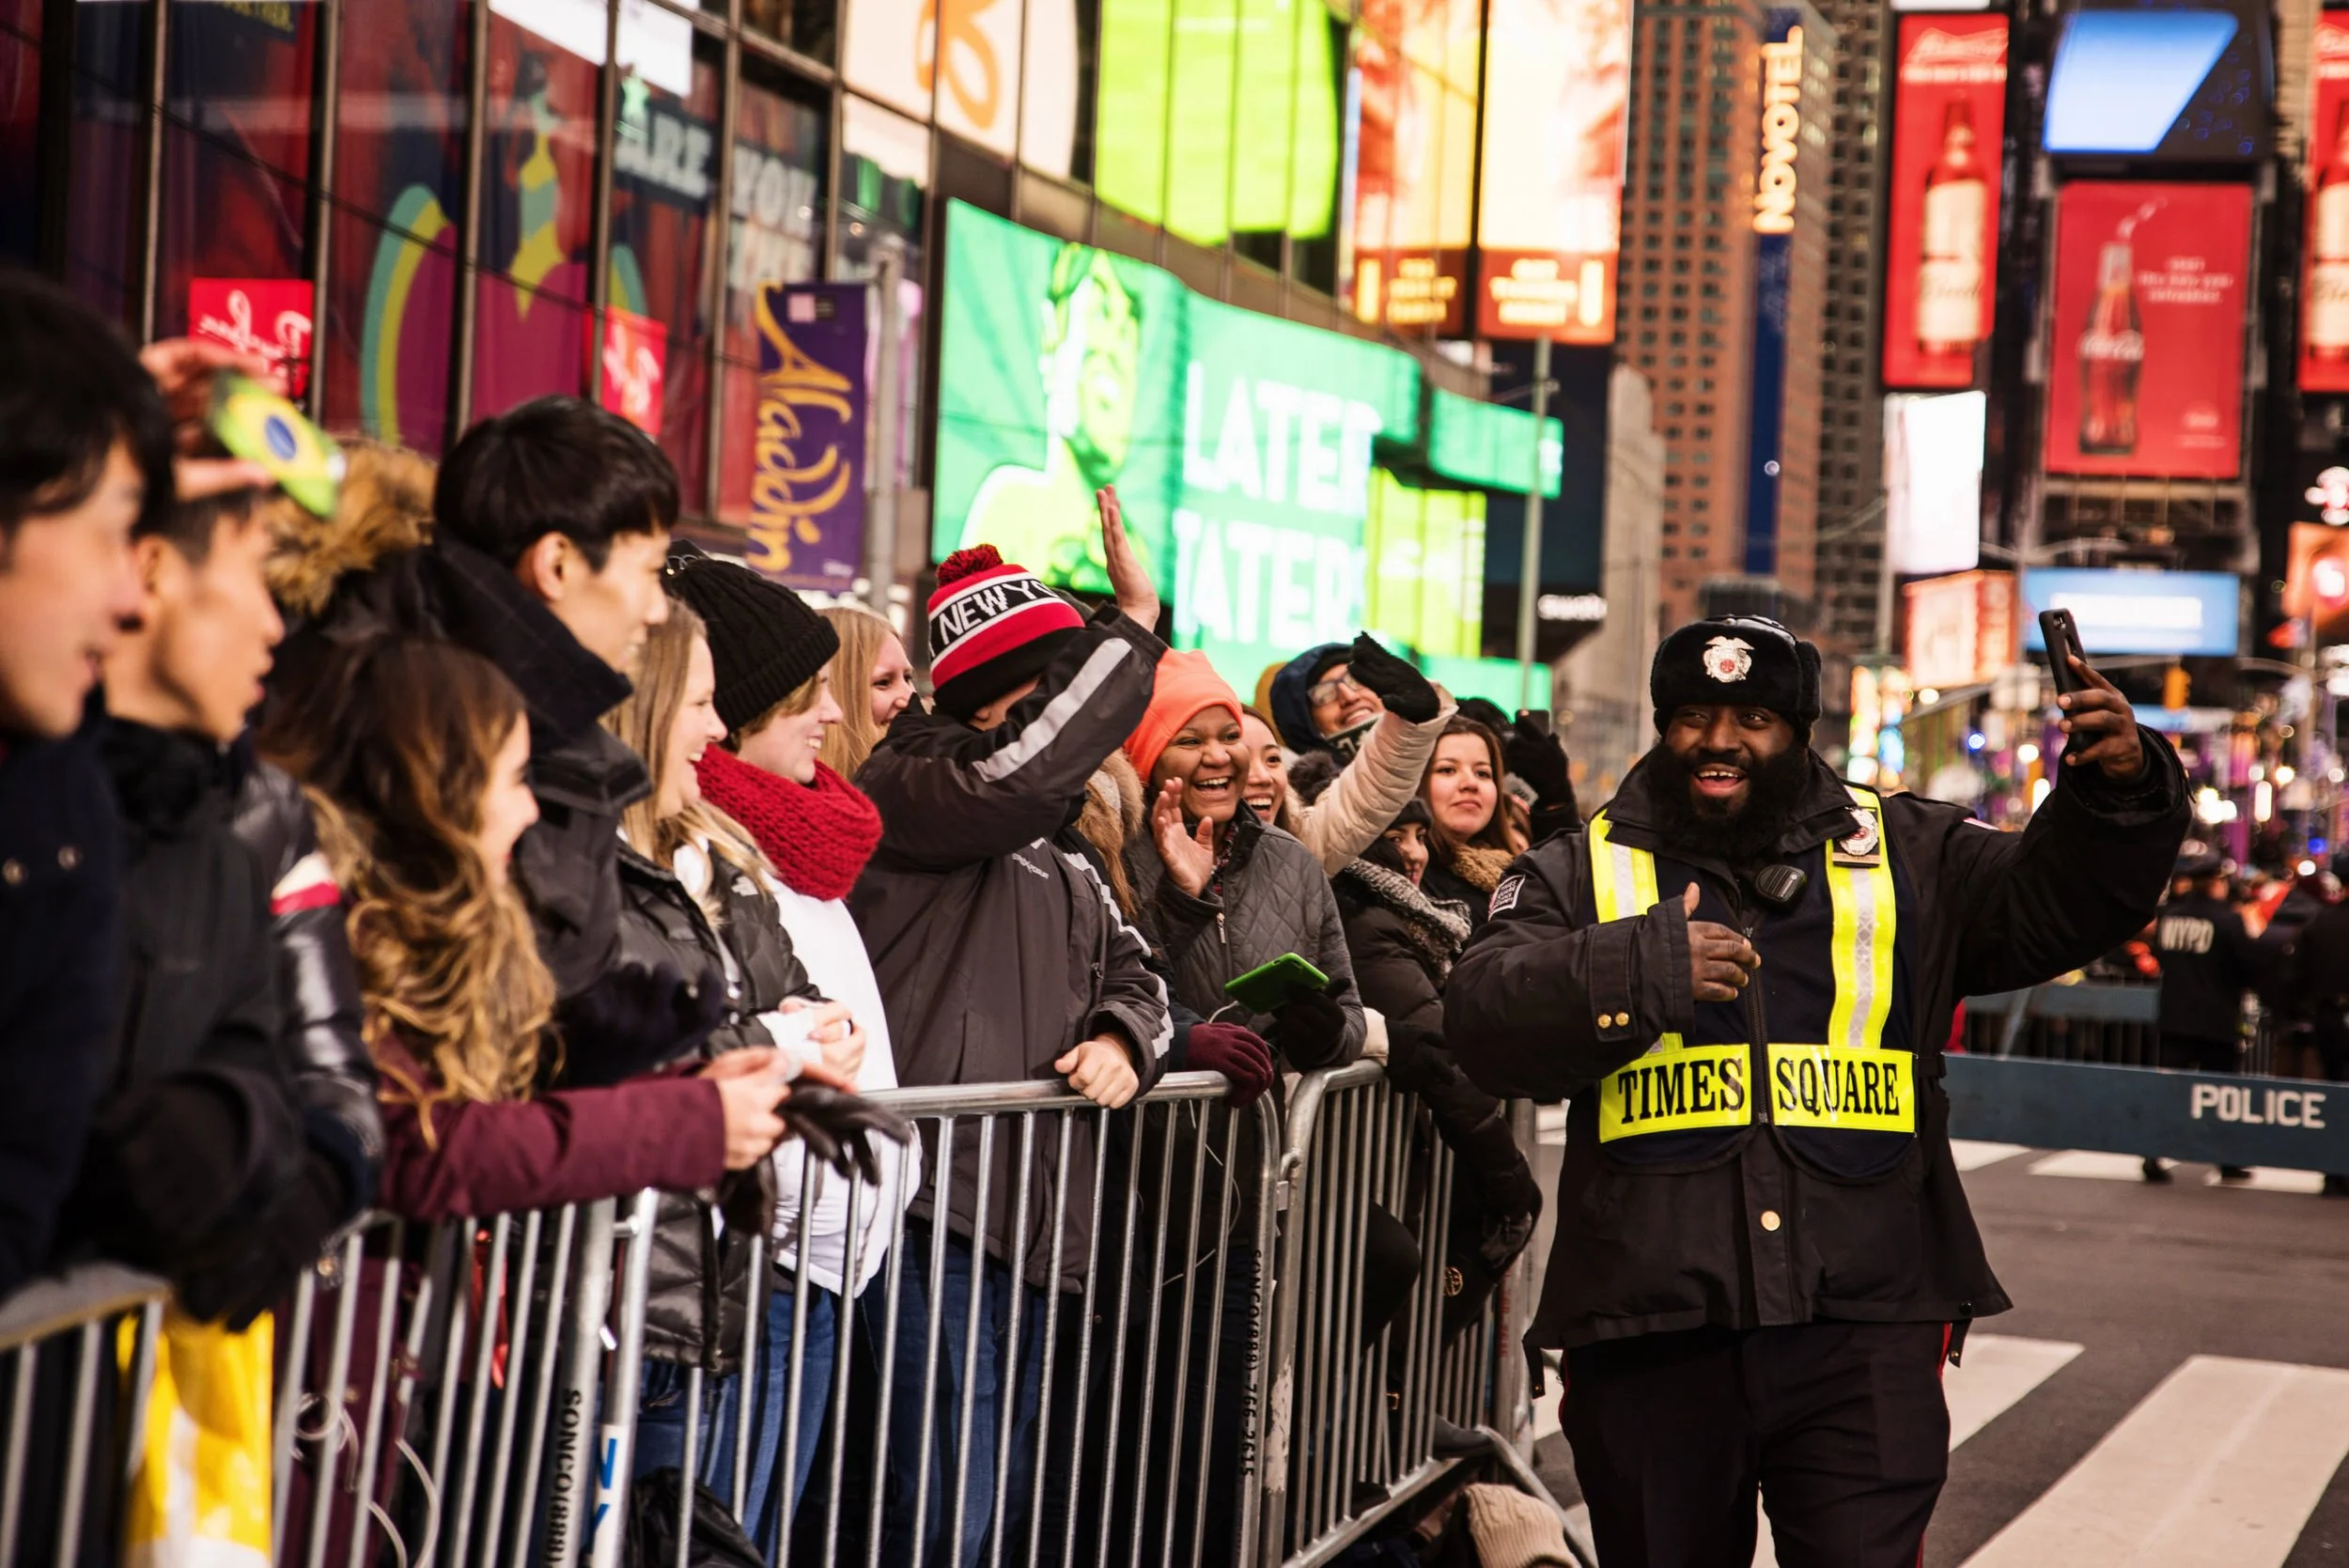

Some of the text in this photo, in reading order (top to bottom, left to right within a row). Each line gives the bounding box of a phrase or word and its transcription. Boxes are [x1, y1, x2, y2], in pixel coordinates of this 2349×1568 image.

[614, 106, 712, 199] ARE
[1753, 25, 1803, 234] NOVOTEL
[747, 282, 853, 571] Aladdin
[940, 583, 1009, 644] NEW
[2161, 916, 2215, 954] NYPD
[1618, 1056, 1899, 1124] TIMES SQUARE
[2191, 1083, 2326, 1129] POLICE
